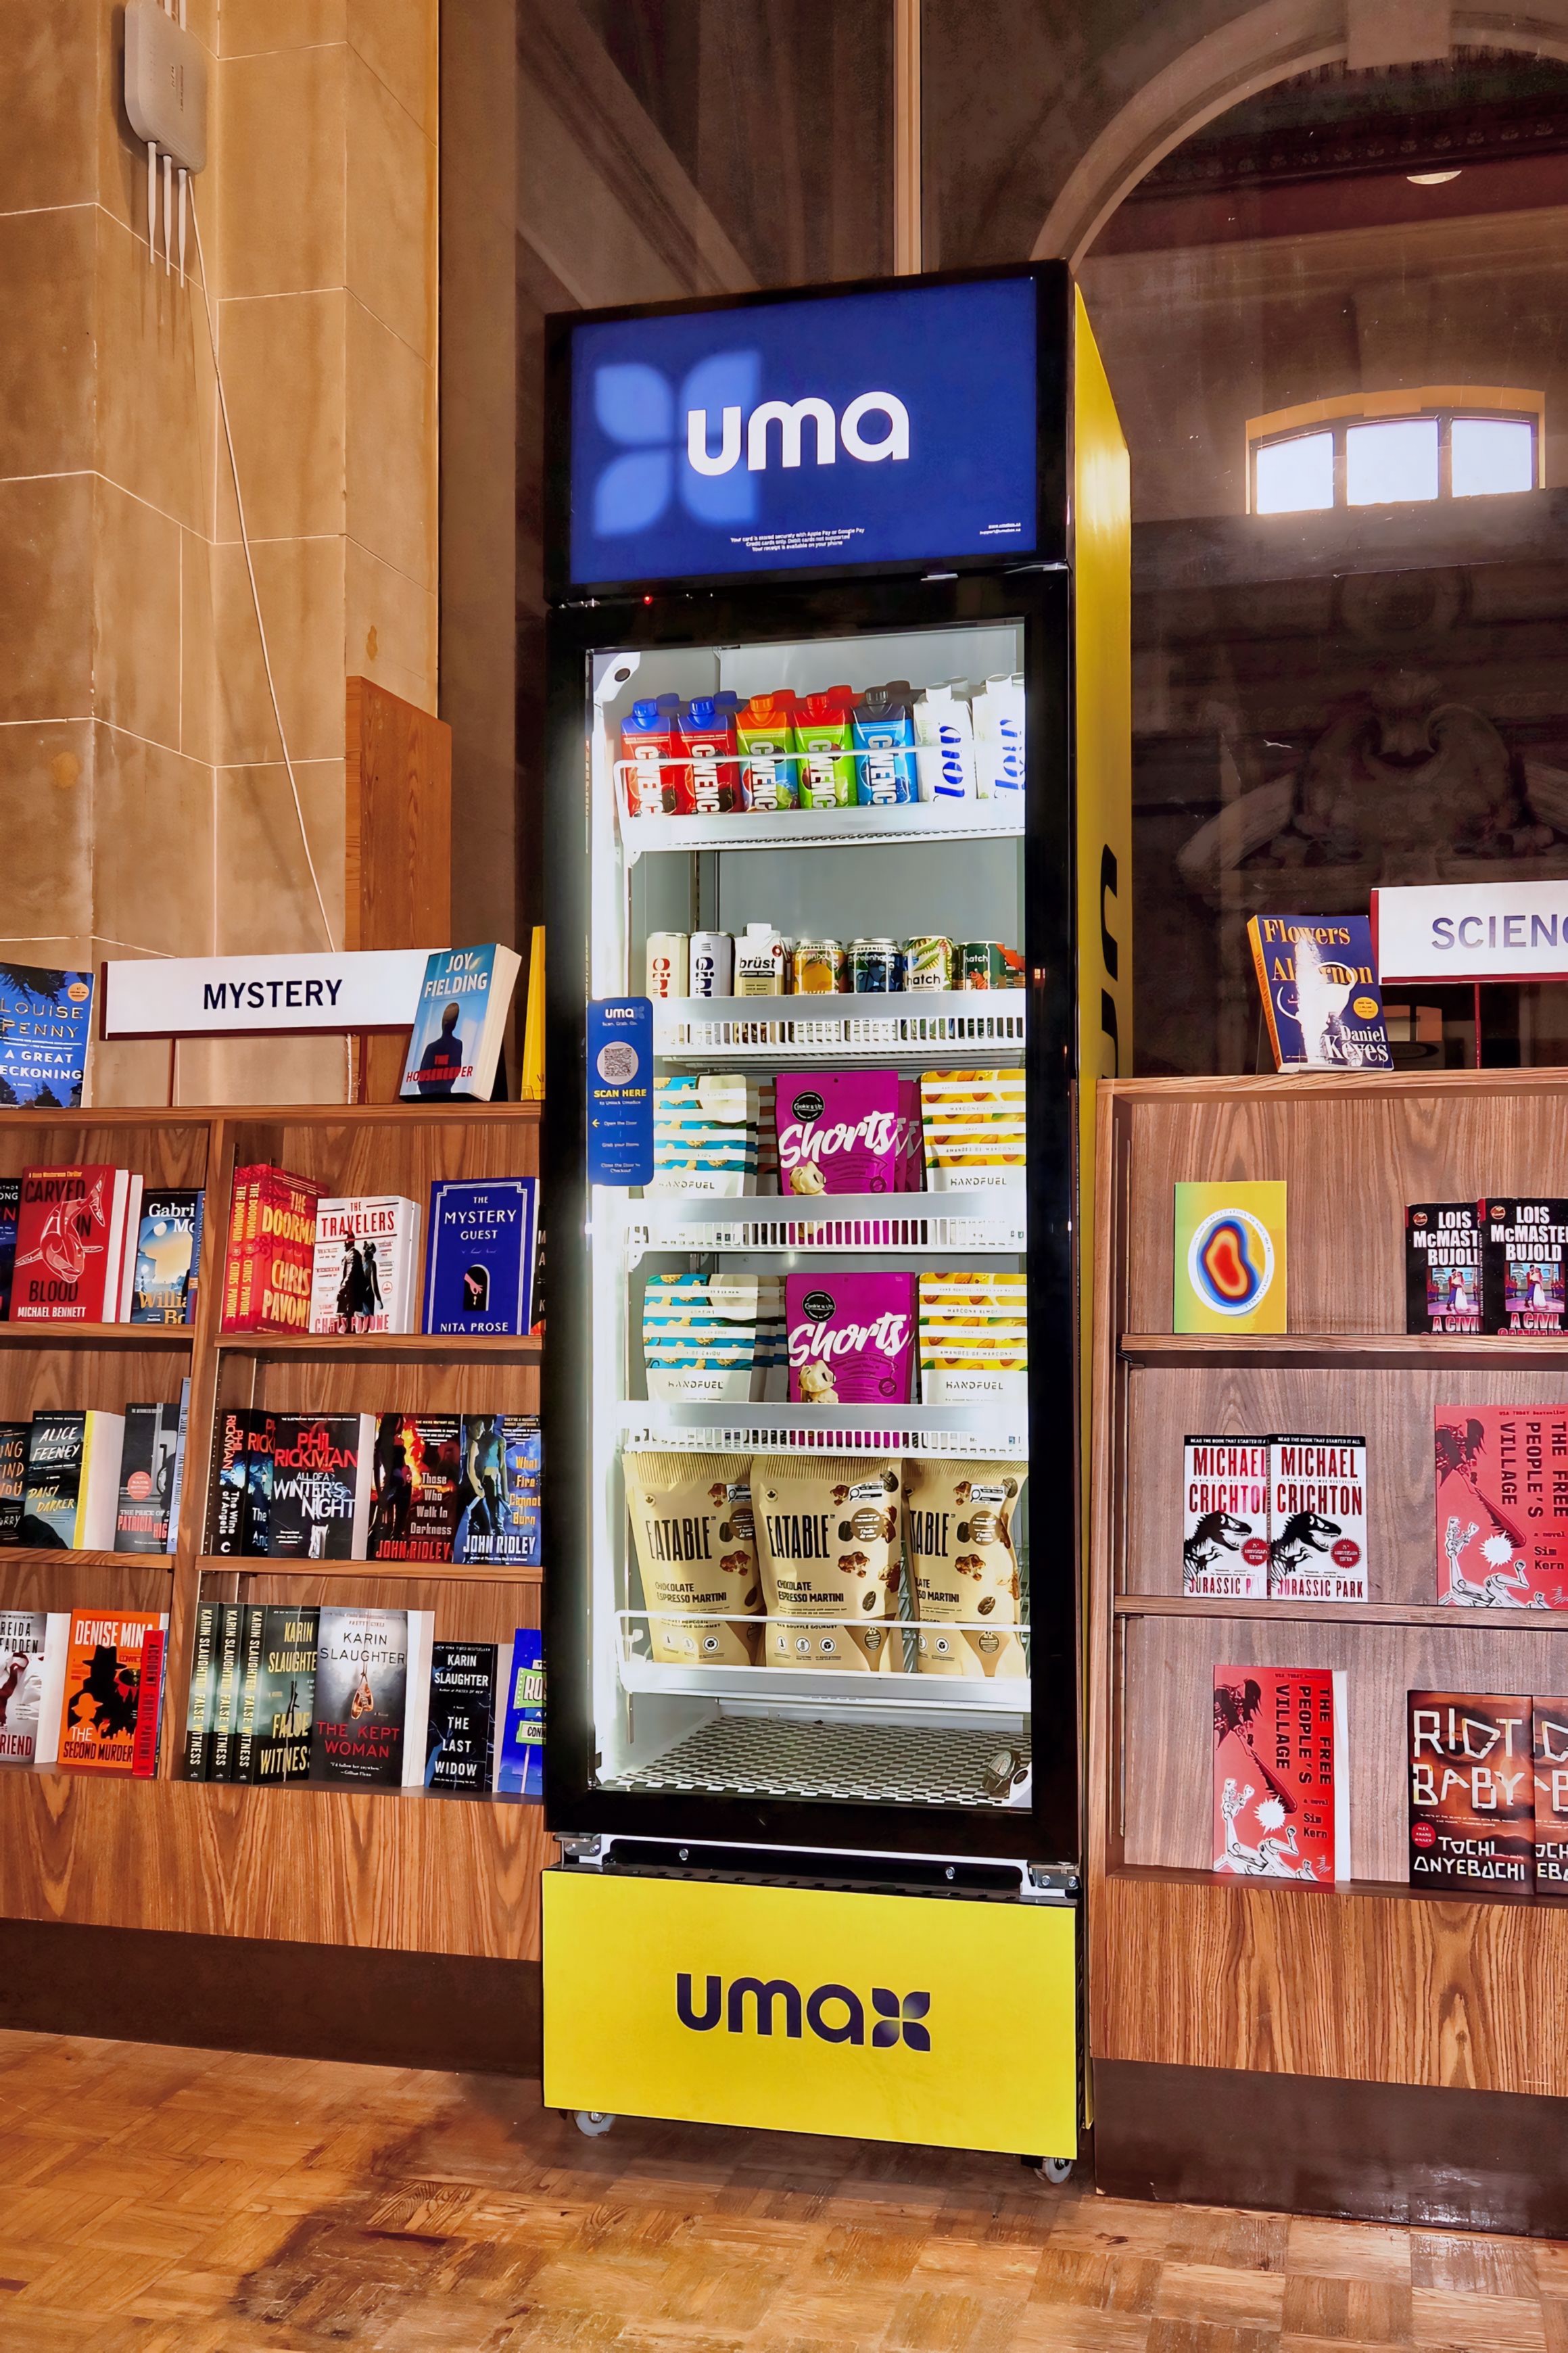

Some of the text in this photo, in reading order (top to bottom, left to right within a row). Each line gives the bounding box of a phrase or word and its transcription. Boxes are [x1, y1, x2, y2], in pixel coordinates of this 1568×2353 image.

[687, 391, 910, 477] uma
[1262, 919, 1351, 946] Flowers
[1431, 913, 1568, 950] SCIEN
[446, 951, 474, 974] JOY
[739, 956, 776, 970] brüst
[203, 978, 343, 1010] MYSTERY
[423, 972, 488, 999] FIELDING
[0, 997, 84, 1020] LOUISE
[605, 1008, 634, 1020] uma
[1, 1018, 80, 1039] PENNY
[1339, 1024, 1386, 1043] Daniel
[4, 1049, 74, 1064] A GREAT
[1323, 1034, 1389, 1067] Keyes
[593, 1088, 647, 1098] SCAN HERE
[778, 1110, 898, 1169] Shorts
[950, 1176, 1007, 1186] HANDFUEL
[24, 1179, 86, 1204] CARVED
[245, 1183, 260, 1239] THE DOORMAN
[290, 1190, 306, 1214] THE
[350, 1201, 362, 1212] THE
[232, 1185, 247, 1241] THE DOORMAN
[444, 1209, 517, 1225] MYSTERY
[1438, 1210, 1472, 1229] LOIS
[1516, 1206, 1550, 1225] LOIS
[76, 1214, 92, 1238] IN
[321, 1210, 395, 1237] TRAVELERS
[460, 1229, 498, 1241] GUEST
[1506, 1243, 1562, 1262] BUJOLD
[271, 1259, 312, 1297] CHRIS
[28, 1279, 80, 1303] BLOOD
[18, 1306, 87, 1318] MICHAEL BENNETT
[1510, 1312, 1561, 1329] A CIVIL
[440, 1322, 508, 1333] NITA PROSE
[1432, 1316, 1443, 1332] A
[788, 1311, 910, 1368] Shorts
[946, 1381, 1003, 1390] HANDFUEL
[39, 1425, 80, 1444] ALICE
[222, 1415, 237, 1471] RICKMAN
[298, 1433, 335, 1452] PHIL
[1551, 1421, 1567, 1456] THE
[32, 1444, 81, 1463] FEENEY
[274, 1448, 359, 1469] RICKMAN
[515, 1456, 539, 1469] What
[1193, 1447, 1266, 1477] MICHAEL
[1281, 1446, 1358, 1478] MICHAEL
[1500, 1421, 1518, 1506] VILLAGE
[1525, 1422, 1544, 1519] PEOPLE'S
[296, 1471, 330, 1482] ALL OF A
[421, 1472, 448, 1485] Those
[516, 1475, 536, 1488] Fire
[28, 1484, 60, 1500] DAISY
[273, 1478, 345, 1500] WINTER'S
[423, 1489, 443, 1502] Who
[36, 1498, 76, 1514] DARKER
[301, 1494, 357, 1521] NIGHT
[1277, 1483, 1362, 1515] CRICHTON
[416, 1505, 448, 1518] Walk In
[513, 1512, 536, 1525] Burn
[117, 1515, 153, 1533] PATRICIA
[410, 1522, 452, 1535] Darkness
[375, 1540, 451, 1561] JOHN RIDLEY
[462, 1534, 536, 1555] JOHN RIDLEY
[1534, 1546, 1557, 1556] Sim
[1534, 1559, 1564, 1570] Kern
[777, 1579, 812, 1591] CHOCOLATE
[1277, 1578, 1363, 1598] JURASSIC PARK
[692, 1591, 728, 1604] MARTINI
[778, 1590, 845, 1603] ESPRESSO MARTINI
[927, 1590, 959, 1603] MARTINI
[74, 1620, 120, 1648] DENISE
[283, 1621, 314, 1643] KARIN
[343, 1632, 388, 1646] KARIN
[320, 1647, 406, 1665] SLAUGHTER
[447, 1654, 477, 1667] KARIN
[190, 1609, 213, 1765] KARIN FALSE WITNESS
[216, 1609, 238, 1767] KARIN FALSE WITNESS
[239, 1611, 263, 1767] KARIN FALSE WITNESS
[434, 1672, 489, 1687] SLAUGHTER
[316, 1721, 400, 1742] THE KEPT
[447, 1716, 469, 1730] THE
[1275, 1684, 1290, 1770] VILLAGE
[71, 1726, 94, 1742] THE
[1298, 1684, 1312, 1785] PEOPLE'S
[1319, 1687, 1331, 1786] THE FREE
[1413, 1707, 1523, 1760] RIOT
[63, 1741, 133, 1763] SECOND MURDER
[324, 1740, 390, 1759] WOMAN
[442, 1738, 472, 1753] LAST
[434, 1760, 477, 1777] WIDOW
[1412, 1763, 1526, 1810] BABY
[1303, 1812, 1322, 1824] Sim
[1303, 1827, 1328, 1839] Kern
[1438, 1836, 1496, 1857] TOCHI
